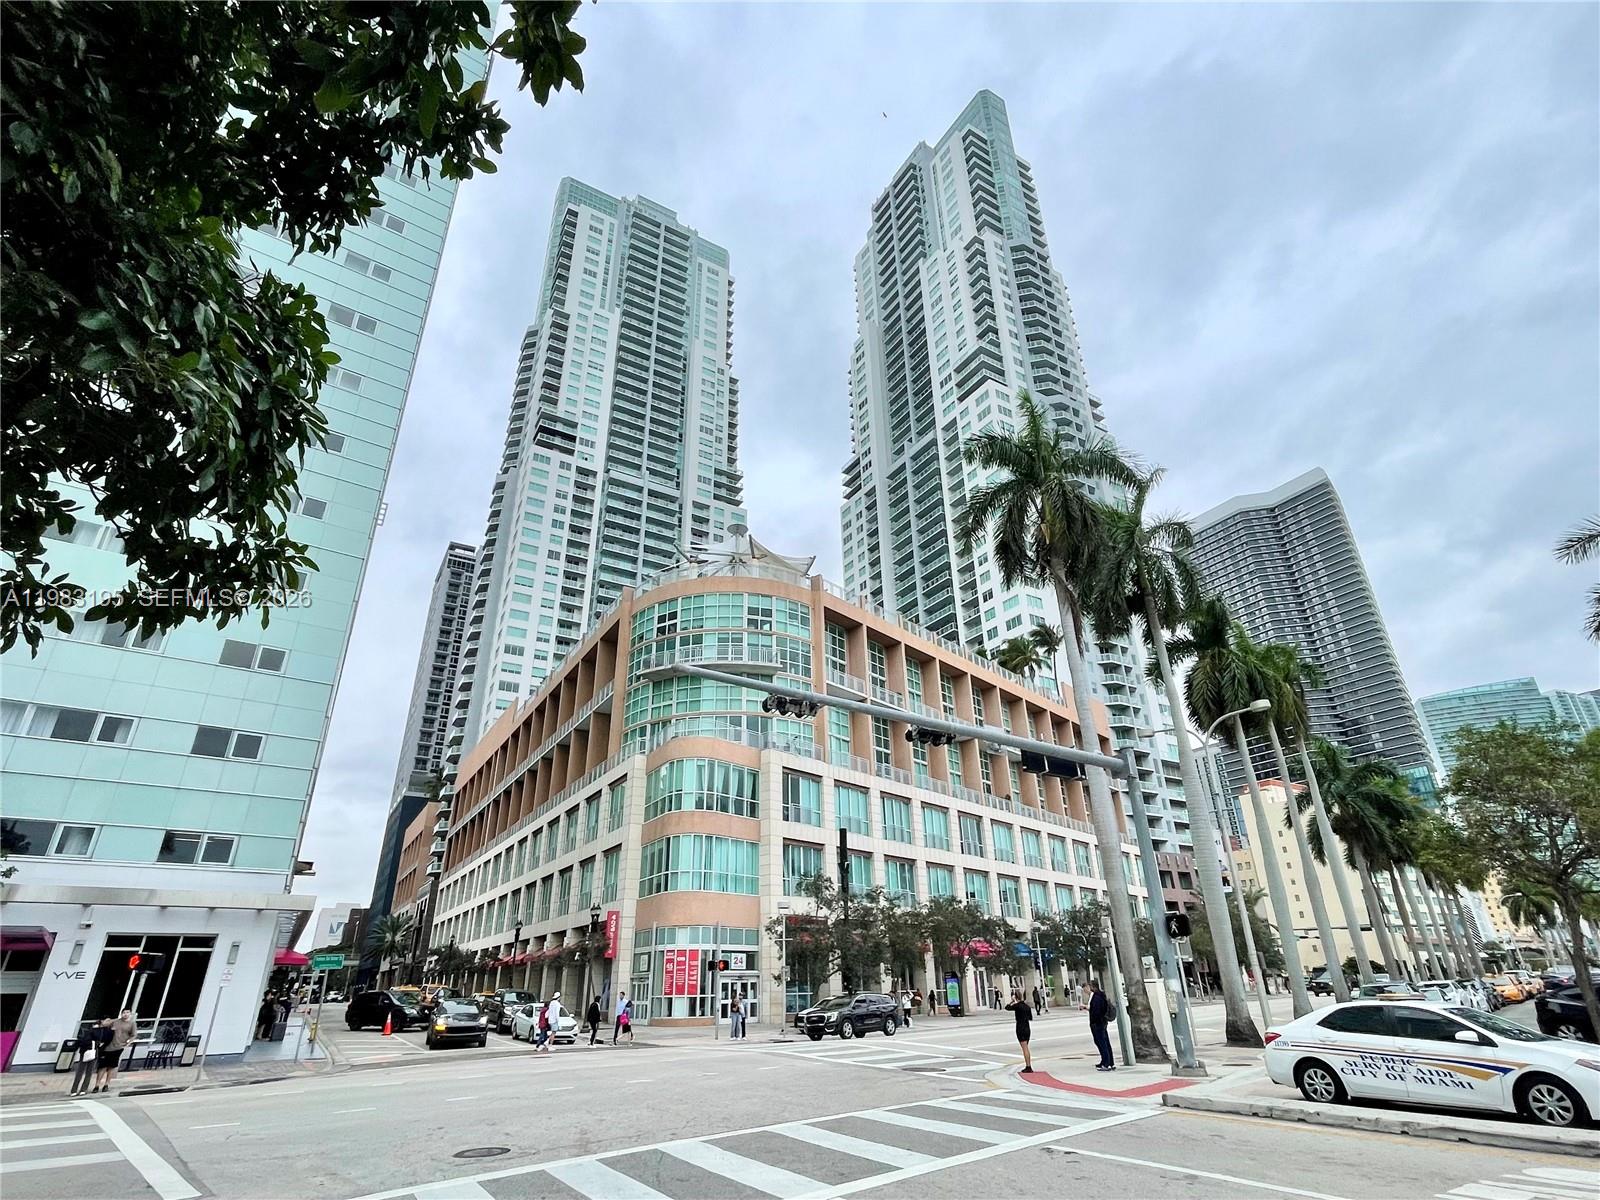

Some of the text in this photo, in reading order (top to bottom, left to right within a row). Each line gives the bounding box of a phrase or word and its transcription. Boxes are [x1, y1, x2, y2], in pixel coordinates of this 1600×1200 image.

[53, 971, 87, 980] YVE
[1359, 1054, 1418, 1067] PUBLIC
[1344, 1060, 1460, 1079] SERVICE AIDE
[1340, 1067, 1475, 1090] CITY OF MIAMI
